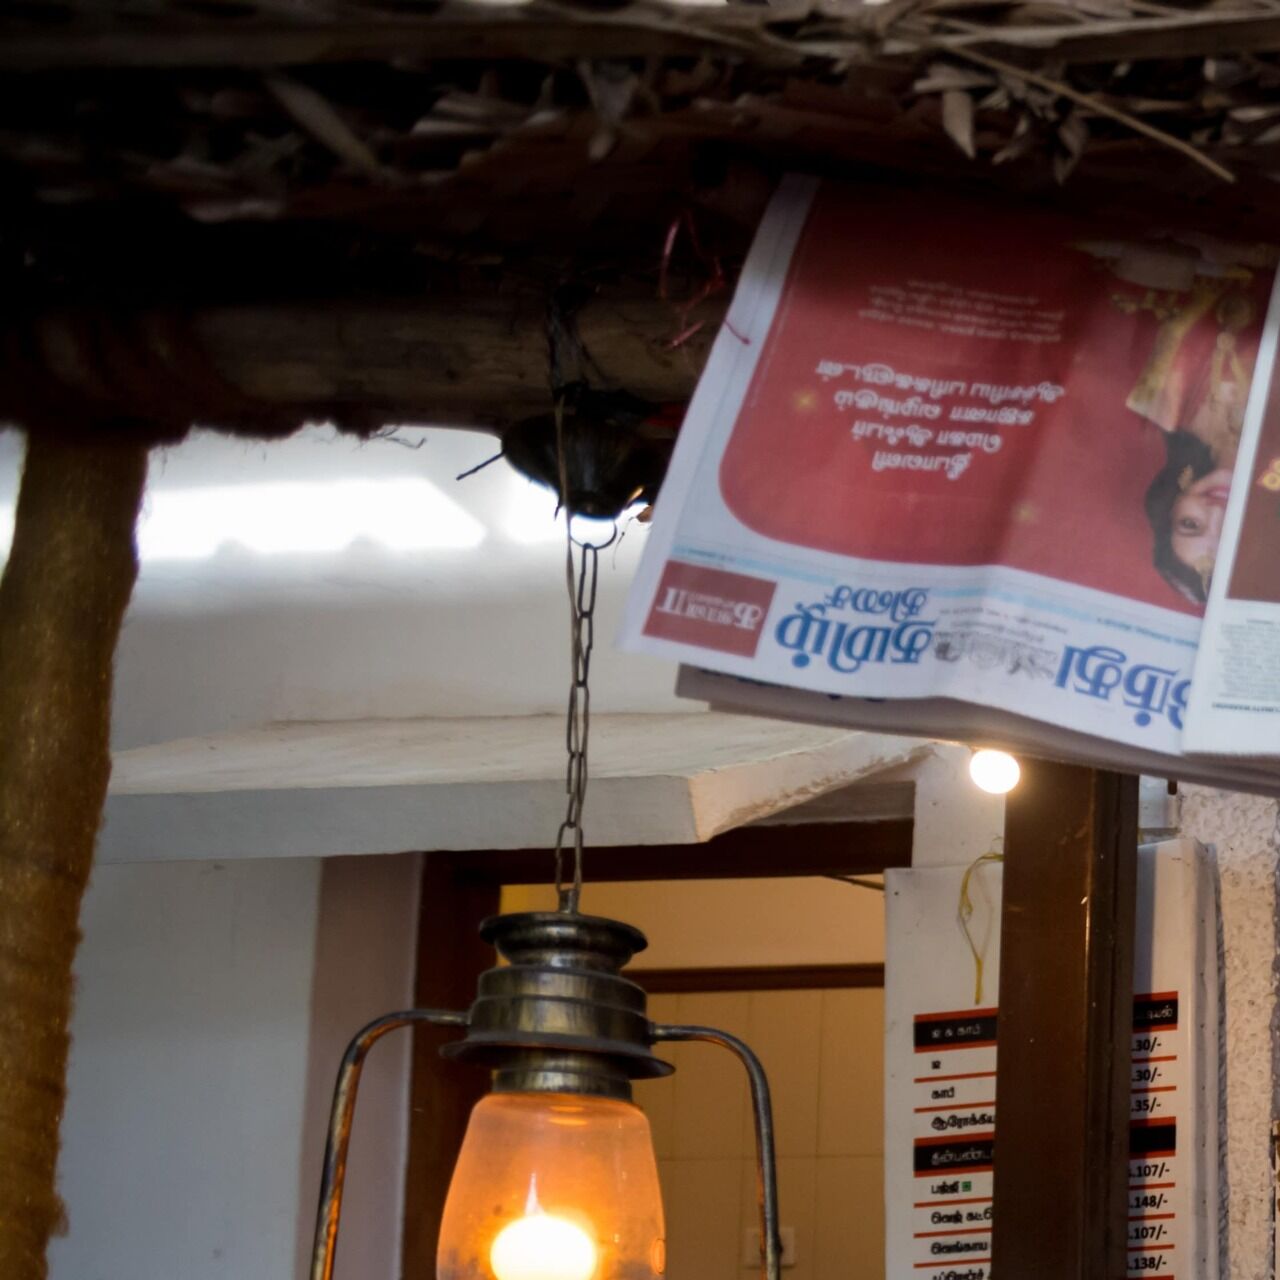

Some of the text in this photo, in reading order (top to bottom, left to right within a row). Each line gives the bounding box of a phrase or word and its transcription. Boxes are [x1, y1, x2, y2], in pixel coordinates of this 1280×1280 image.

[816, 361, 1064, 404] ஆச்சரிய பரிசுகளுடன்
[835, 389, 941, 419] வழங்கும்
[852, 421, 1002, 453] மெகா ஆஃபர்
[872, 451, 971, 480] தீபாவளி
[825, 586, 930, 623] திசை
[775, 603, 936, 673] தமிழ்
[931, 1087, 954, 1099] காபி
[931, 1212, 963, 1224] வெஜ்
